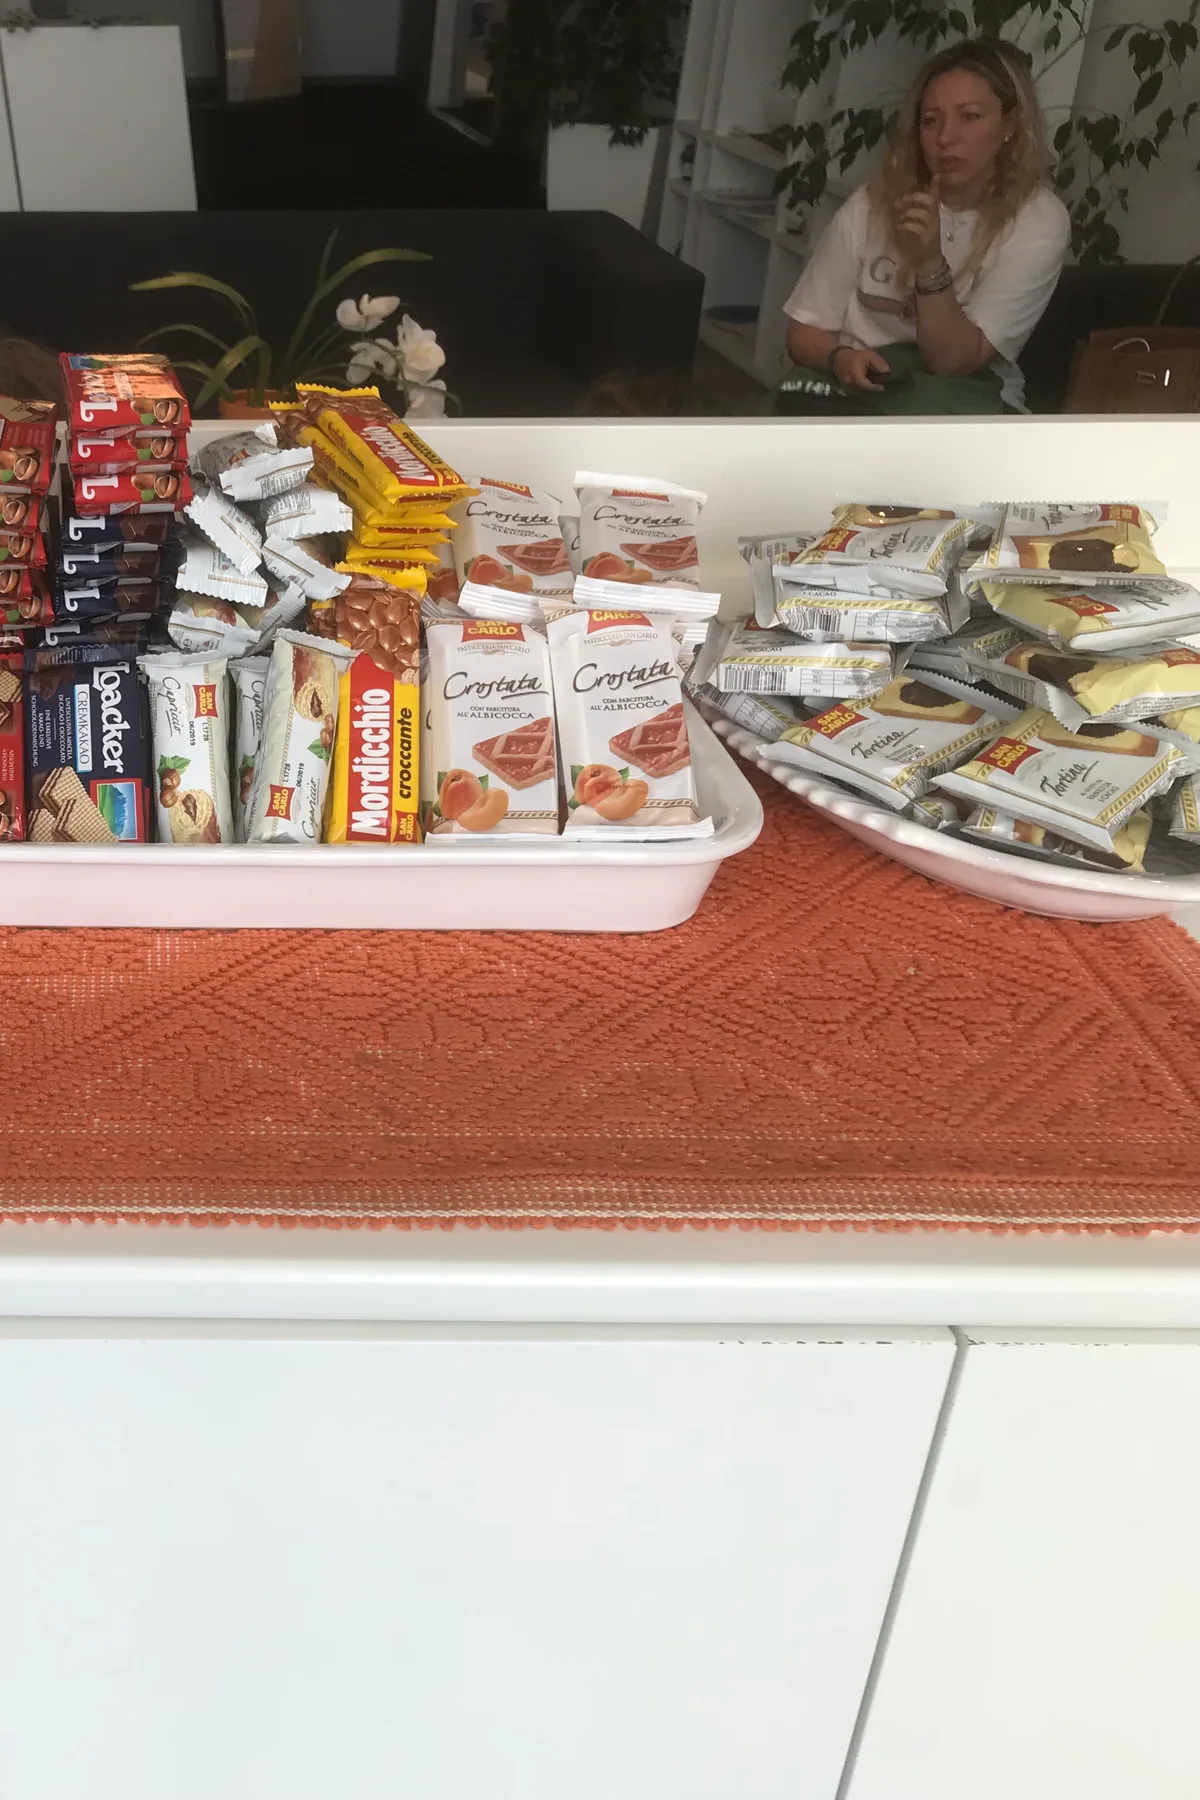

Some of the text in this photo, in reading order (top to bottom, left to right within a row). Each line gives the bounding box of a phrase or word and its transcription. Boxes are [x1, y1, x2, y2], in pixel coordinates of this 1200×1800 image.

[466, 501, 553, 523] Crostata
[594, 506, 687, 525] Crostata
[468, 627, 518, 635] CARLO
[584, 633, 622, 645] PASTICCERIA
[510, 645, 530, 653] CARLO
[443, 671, 542, 700] Crostata
[573, 659, 673, 693] Crostata
[157, 676, 184, 735] Capriccio
[199, 687, 207, 714] CARLO
[603, 700, 669, 711] ALBICOCCA
[77, 691, 89, 764] CREMKAKAO
[93, 661, 131, 773] Loacker
[817, 710, 842, 726] SAN
[820, 713, 856, 734] CARLO
[399, 707, 413, 800] croccante
[851, 731, 904, 760] Tortina
[990, 744, 1014, 760] SAN
[997, 745, 1028, 769] CARLO
[296, 763, 304, 787] 06/2019
[351, 688, 391, 837] Mordicchio
[1040, 763, 1086, 797] Tortina
[272, 792, 281, 810] SAN
[279, 789, 288, 816] CARLO
[406, 814, 414, 840] CARLO
